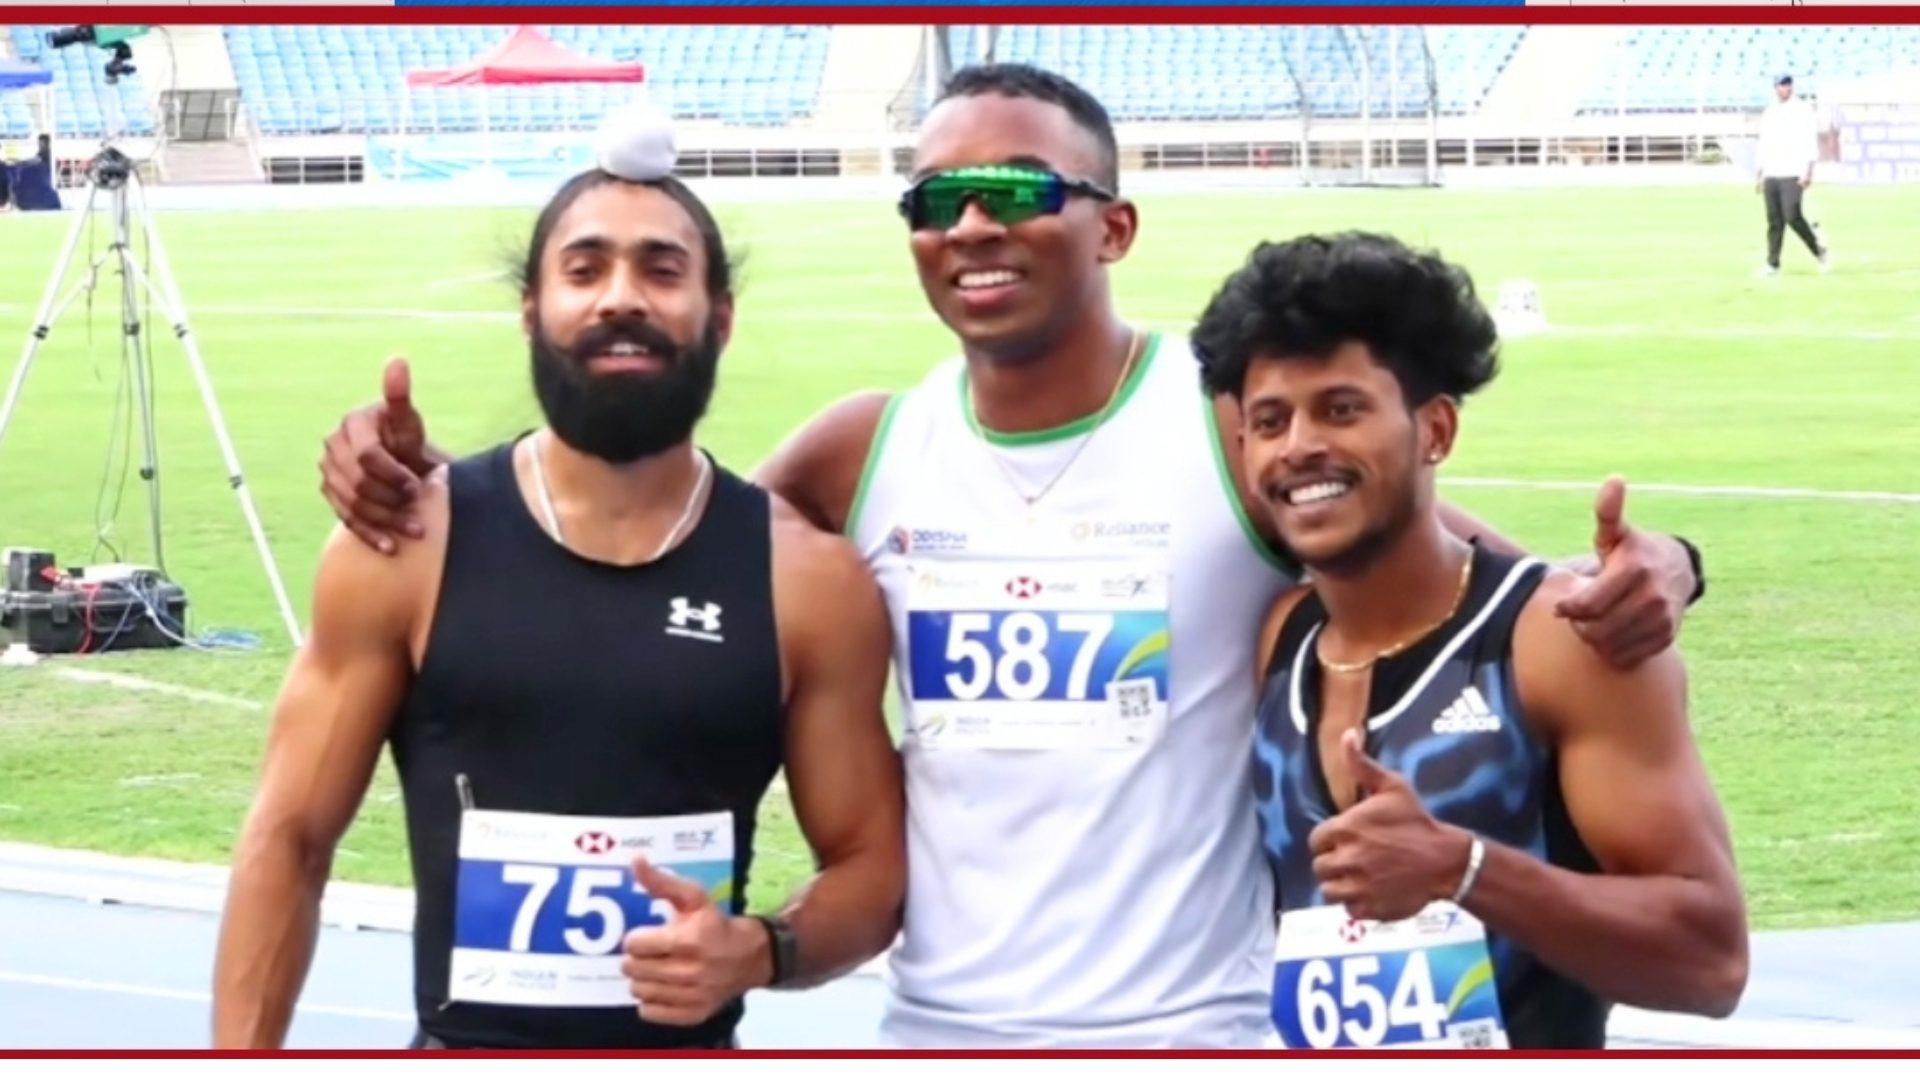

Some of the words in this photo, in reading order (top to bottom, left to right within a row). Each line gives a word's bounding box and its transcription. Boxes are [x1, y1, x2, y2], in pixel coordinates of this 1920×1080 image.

[1093, 521, 1171, 538] Reliance
[945, 612, 1115, 701] 587
[1297, 948, 1448, 1049] 654
